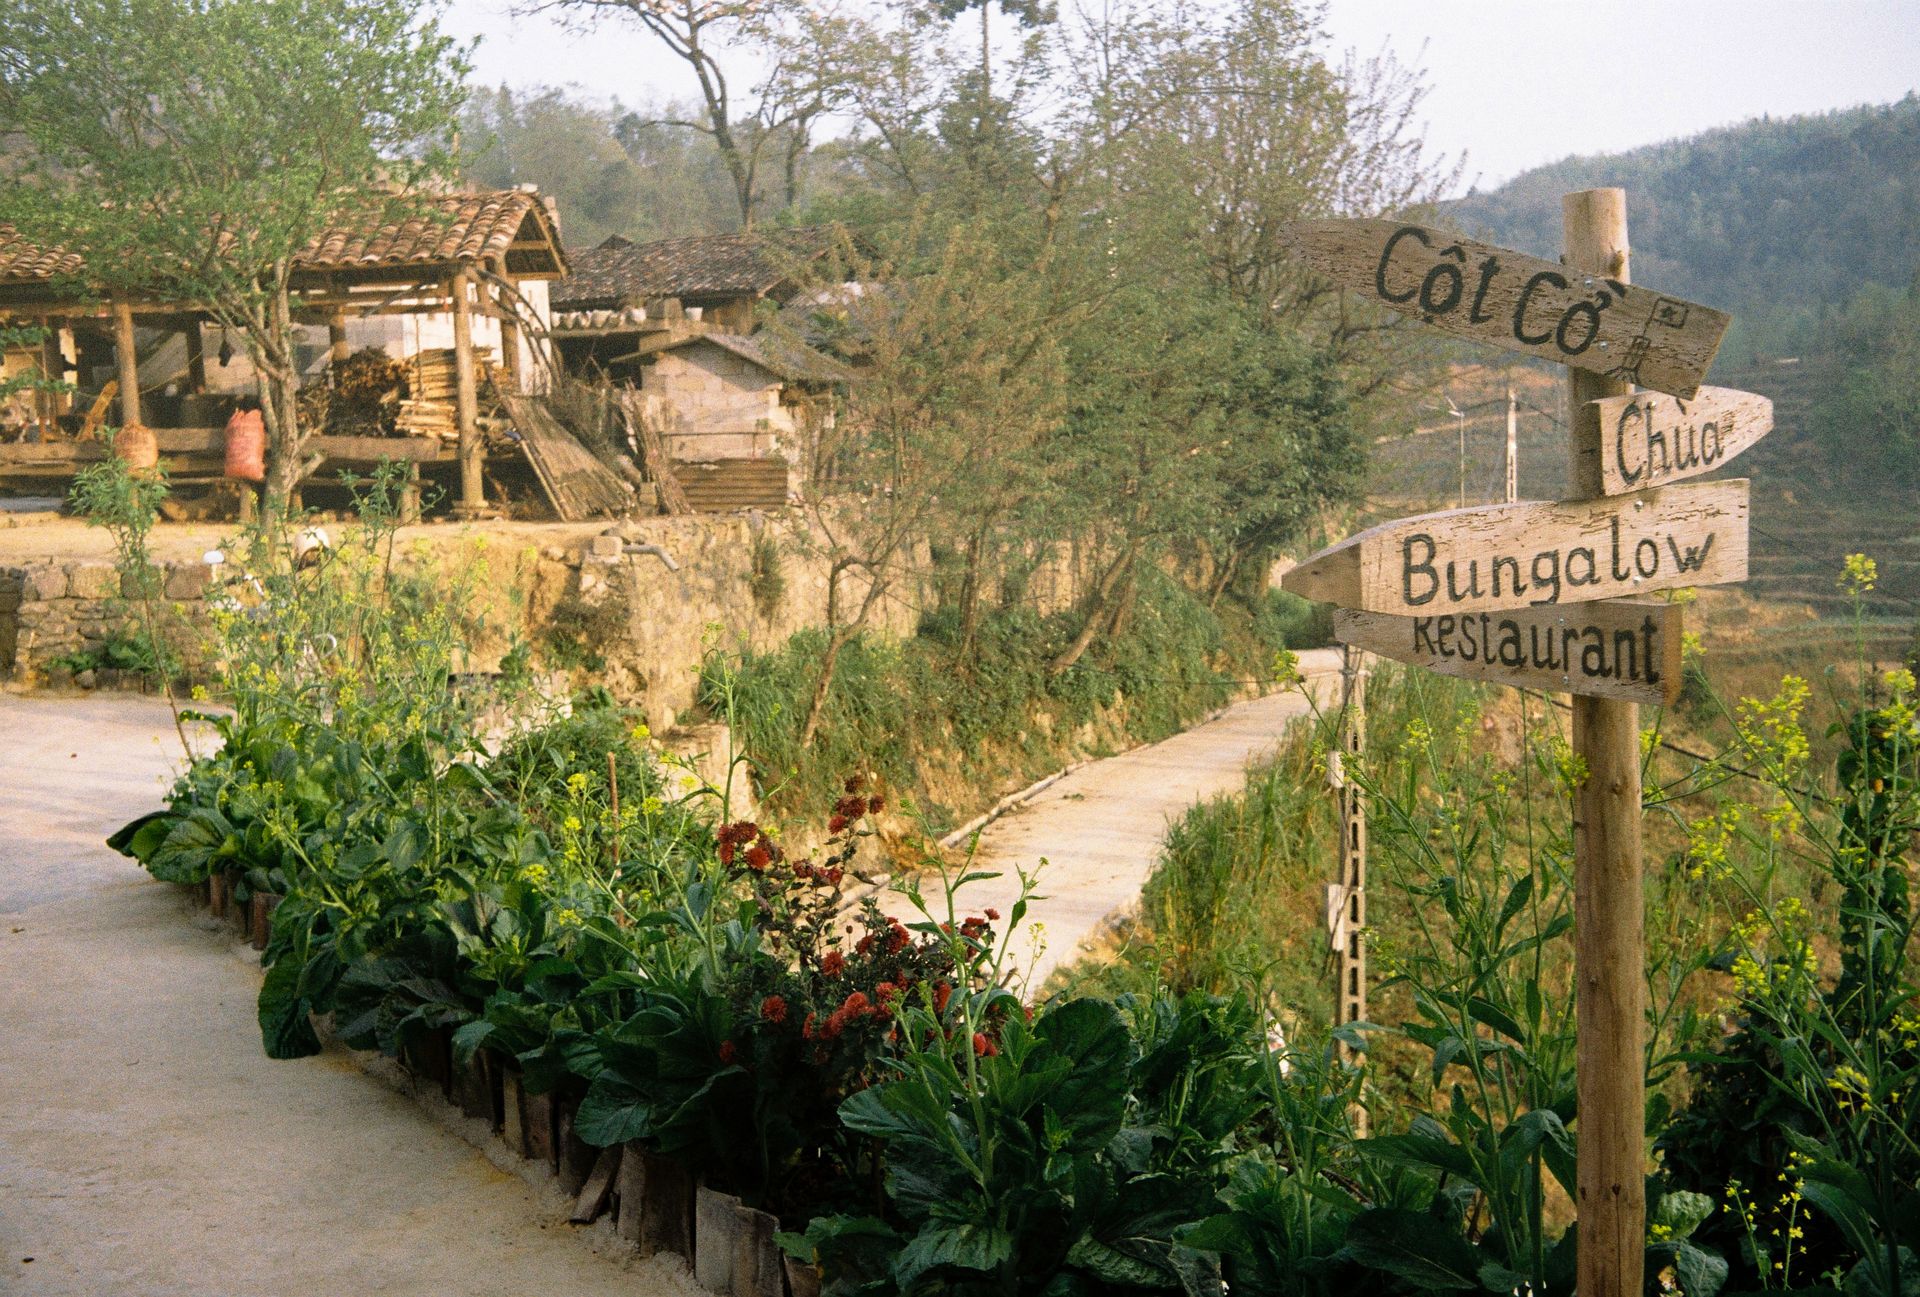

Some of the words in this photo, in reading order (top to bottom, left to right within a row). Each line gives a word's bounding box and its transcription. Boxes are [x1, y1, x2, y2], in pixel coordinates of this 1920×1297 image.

[1513, 271, 1627, 356] Cờ
[1616, 398, 1725, 486] Chùa
[1401, 516, 1716, 606] Bungalow
[1412, 612, 1661, 685] Restaurant
